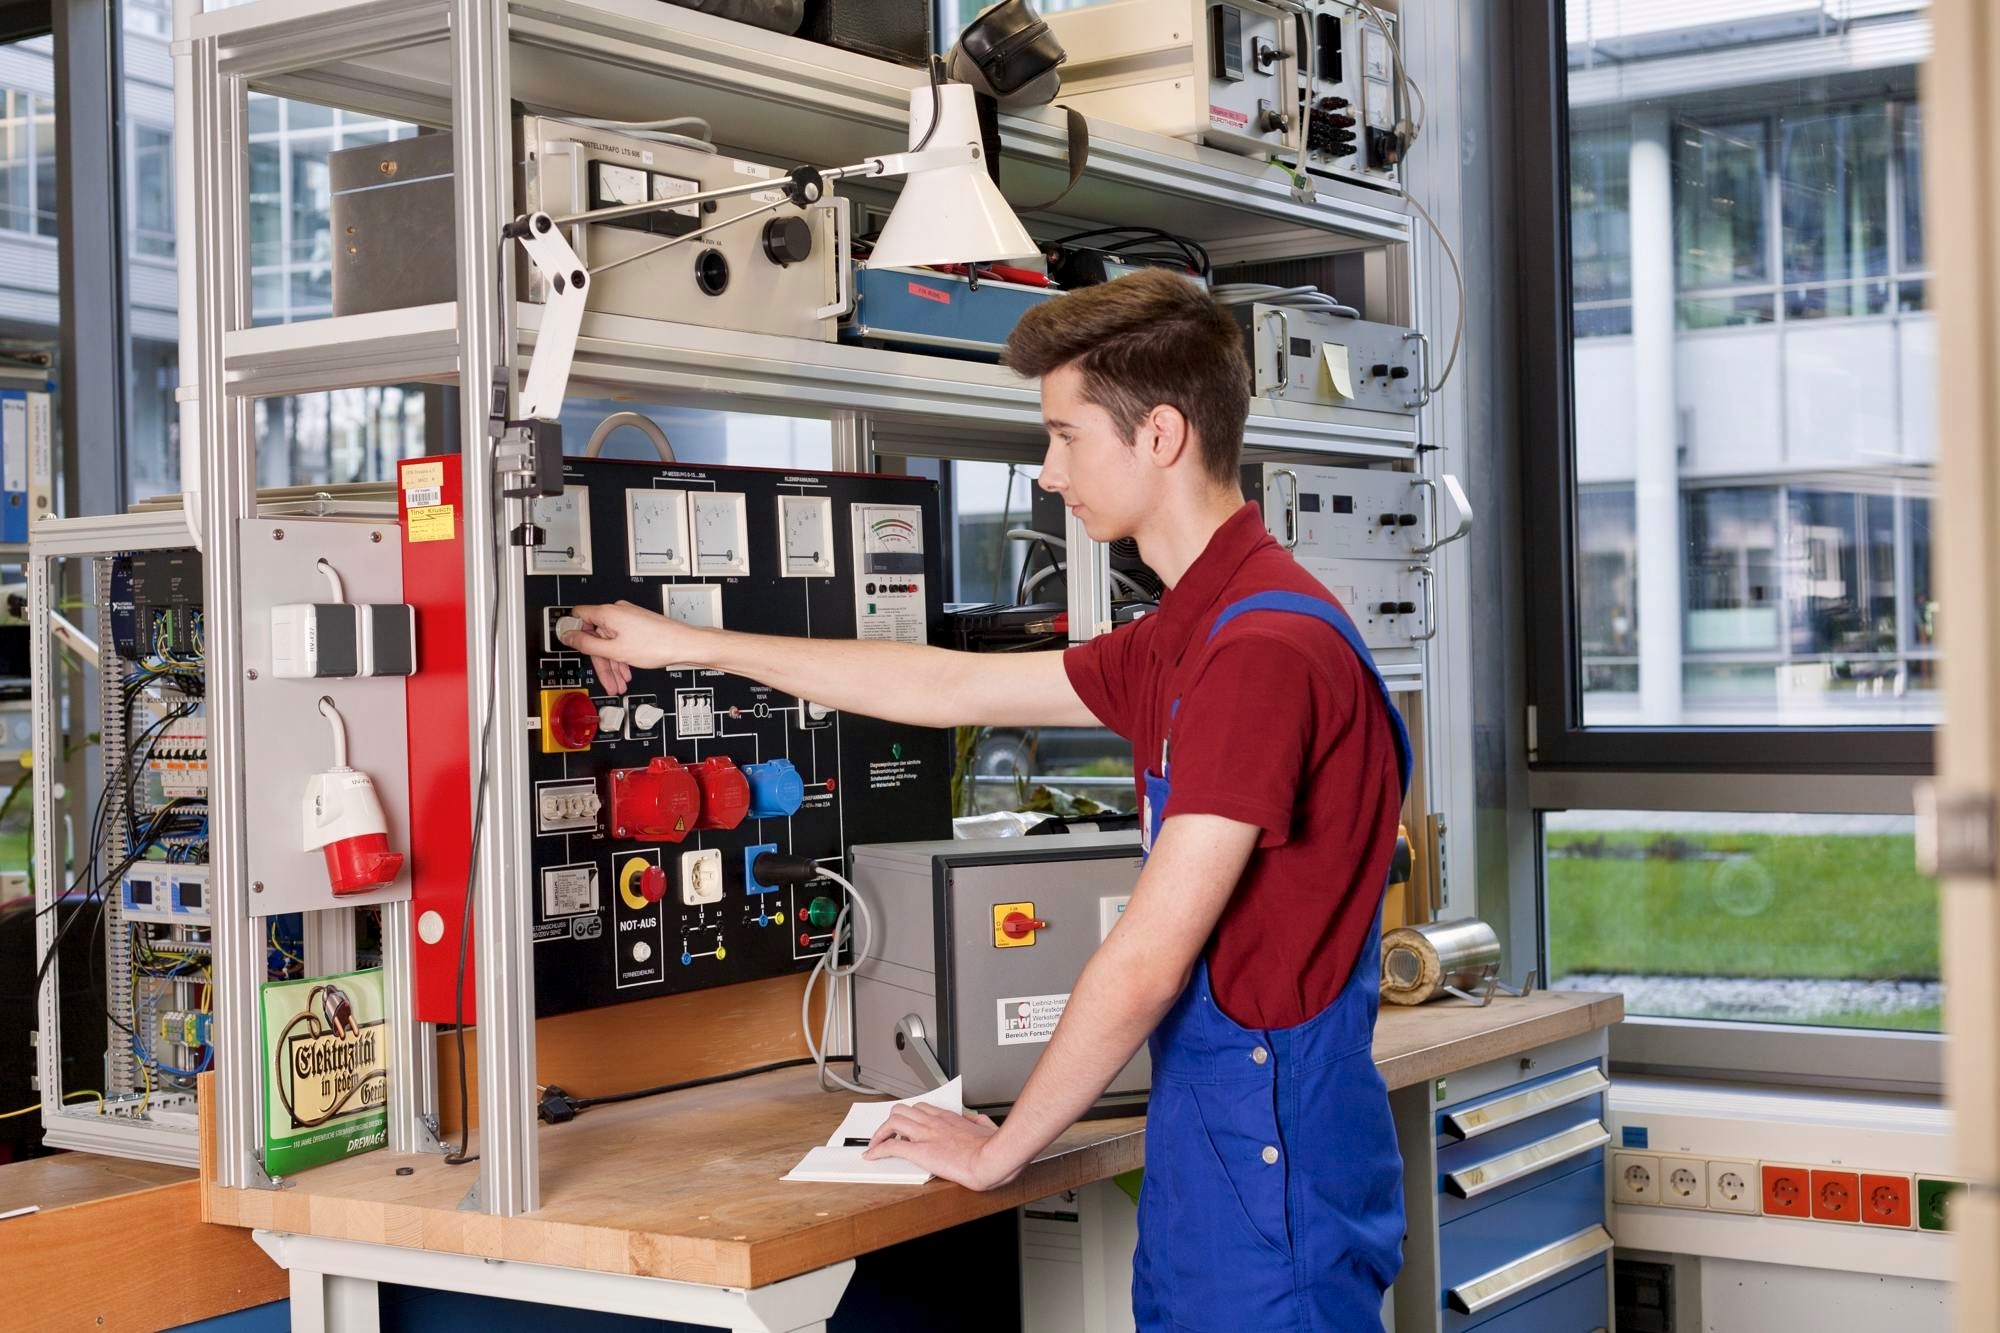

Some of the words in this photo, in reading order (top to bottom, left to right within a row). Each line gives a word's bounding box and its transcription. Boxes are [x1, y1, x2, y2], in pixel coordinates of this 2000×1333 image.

[620, 918, 657, 932] NOT-AUS
[1005, 1031, 1029, 1039] Bereich
[1029, 1029, 1055, 1037] Forschu
[295, 1030, 376, 1079] Elektrizität
[321, 1075, 331, 1097] in
[360, 1079, 385, 1105] Gerä
[346, 1132, 381, 1152] DREWAG
